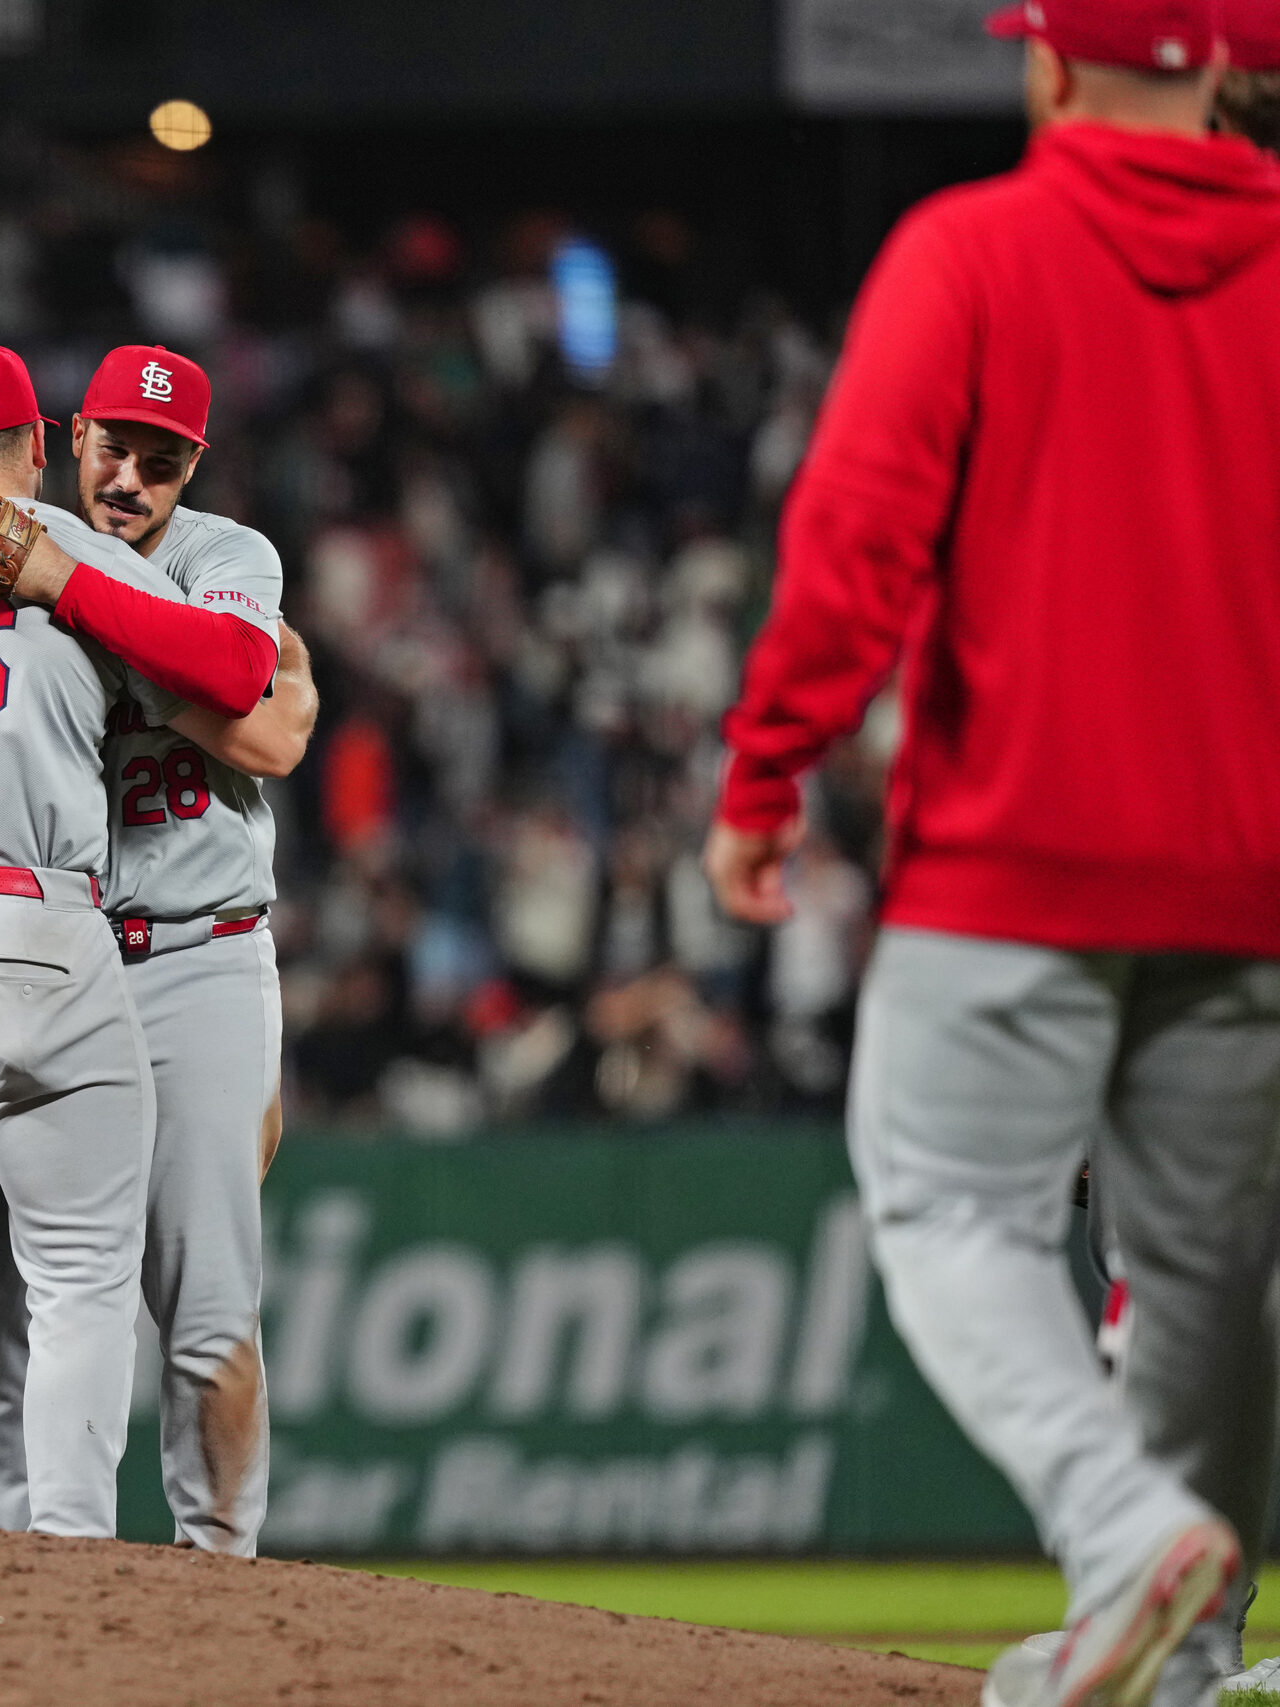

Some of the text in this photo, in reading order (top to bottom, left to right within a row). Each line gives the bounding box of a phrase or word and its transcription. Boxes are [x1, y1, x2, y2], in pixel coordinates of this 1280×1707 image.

[203, 590, 266, 616] STIFEL
[122, 747, 211, 827] 28
[128, 931, 145, 945] 28
